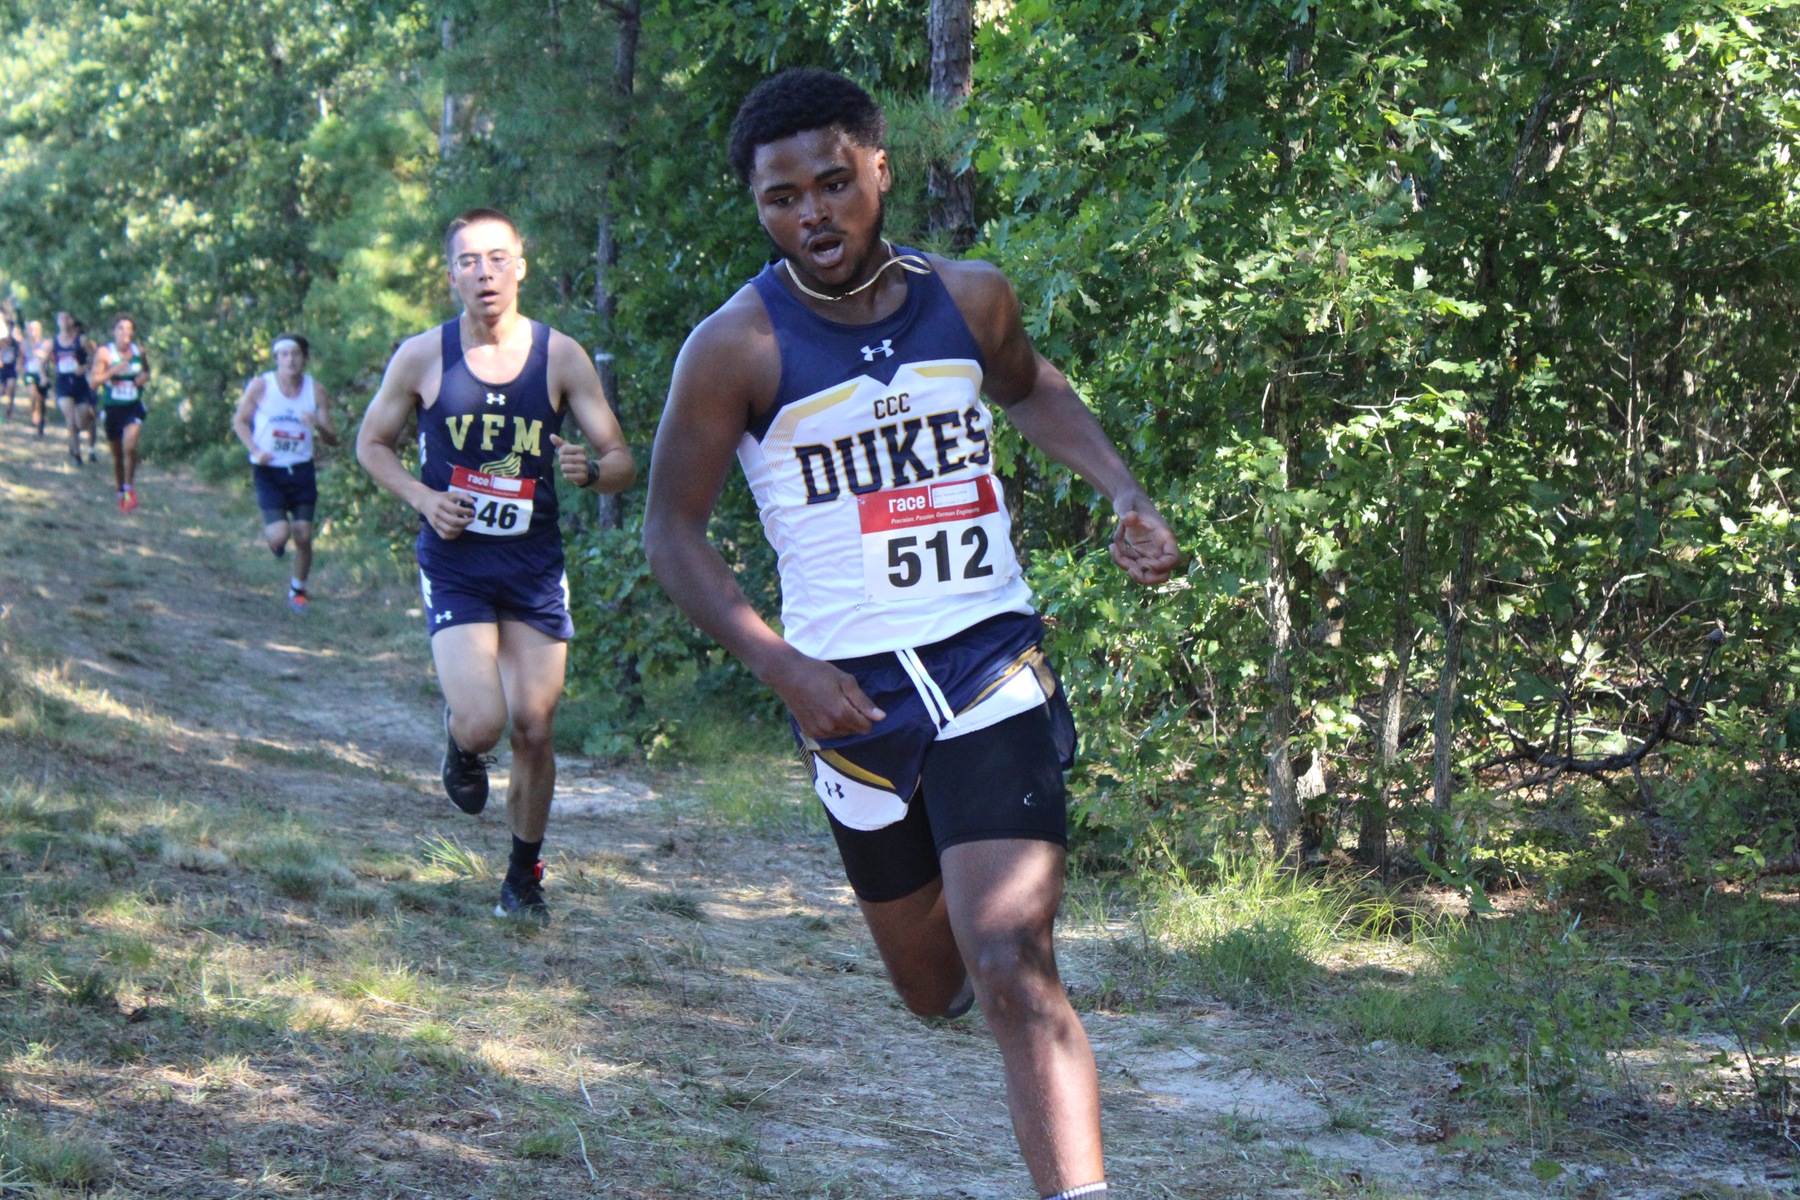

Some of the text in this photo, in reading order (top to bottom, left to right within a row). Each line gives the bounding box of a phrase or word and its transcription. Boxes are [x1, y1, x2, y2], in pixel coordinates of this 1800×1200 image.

[874, 392, 911, 420] CCC
[793, 406, 991, 506] DUKES
[467, 473, 490, 487] race
[888, 495, 926, 514] race
[936, 509, 956, 518] German
[887, 525, 994, 588] 512
